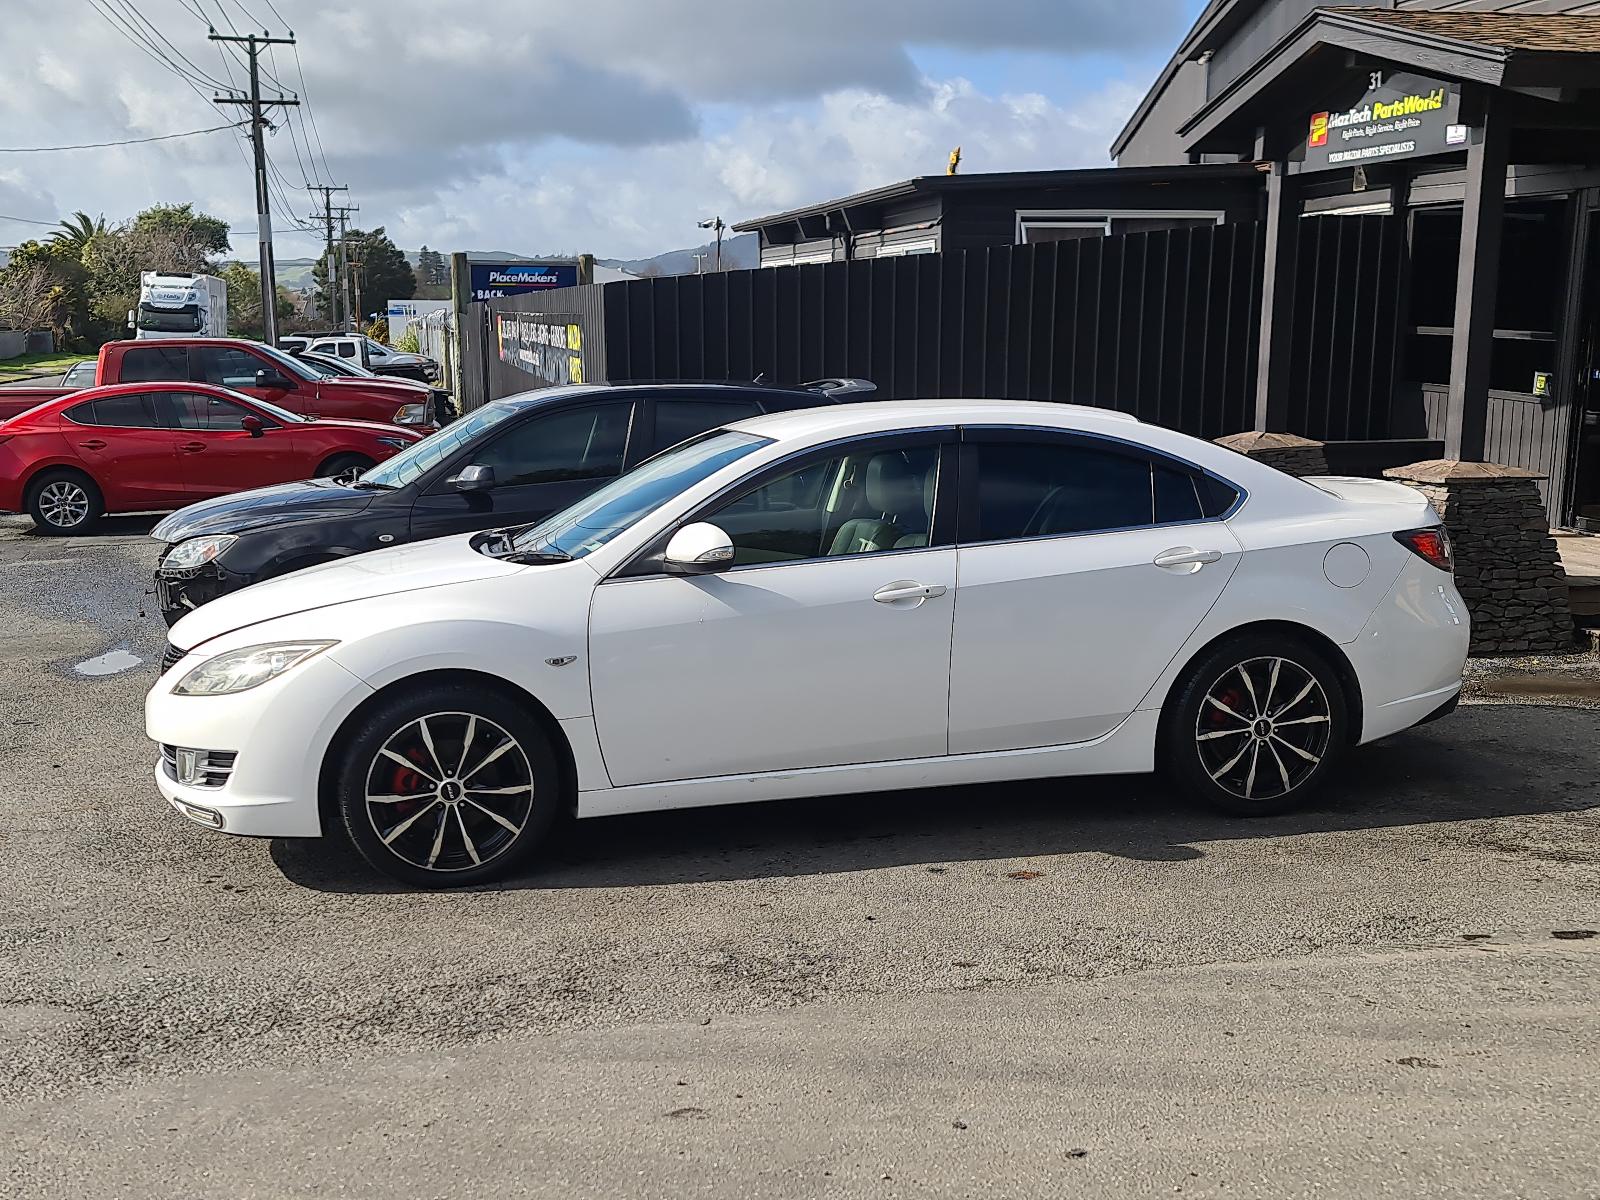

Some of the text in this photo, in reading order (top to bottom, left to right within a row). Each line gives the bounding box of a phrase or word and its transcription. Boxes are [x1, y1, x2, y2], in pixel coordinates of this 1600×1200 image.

[1369, 70, 1382, 90] 31
[1328, 87, 1444, 129] MazTech PartsWorld
[489, 271, 558, 283] PlaceMakers
